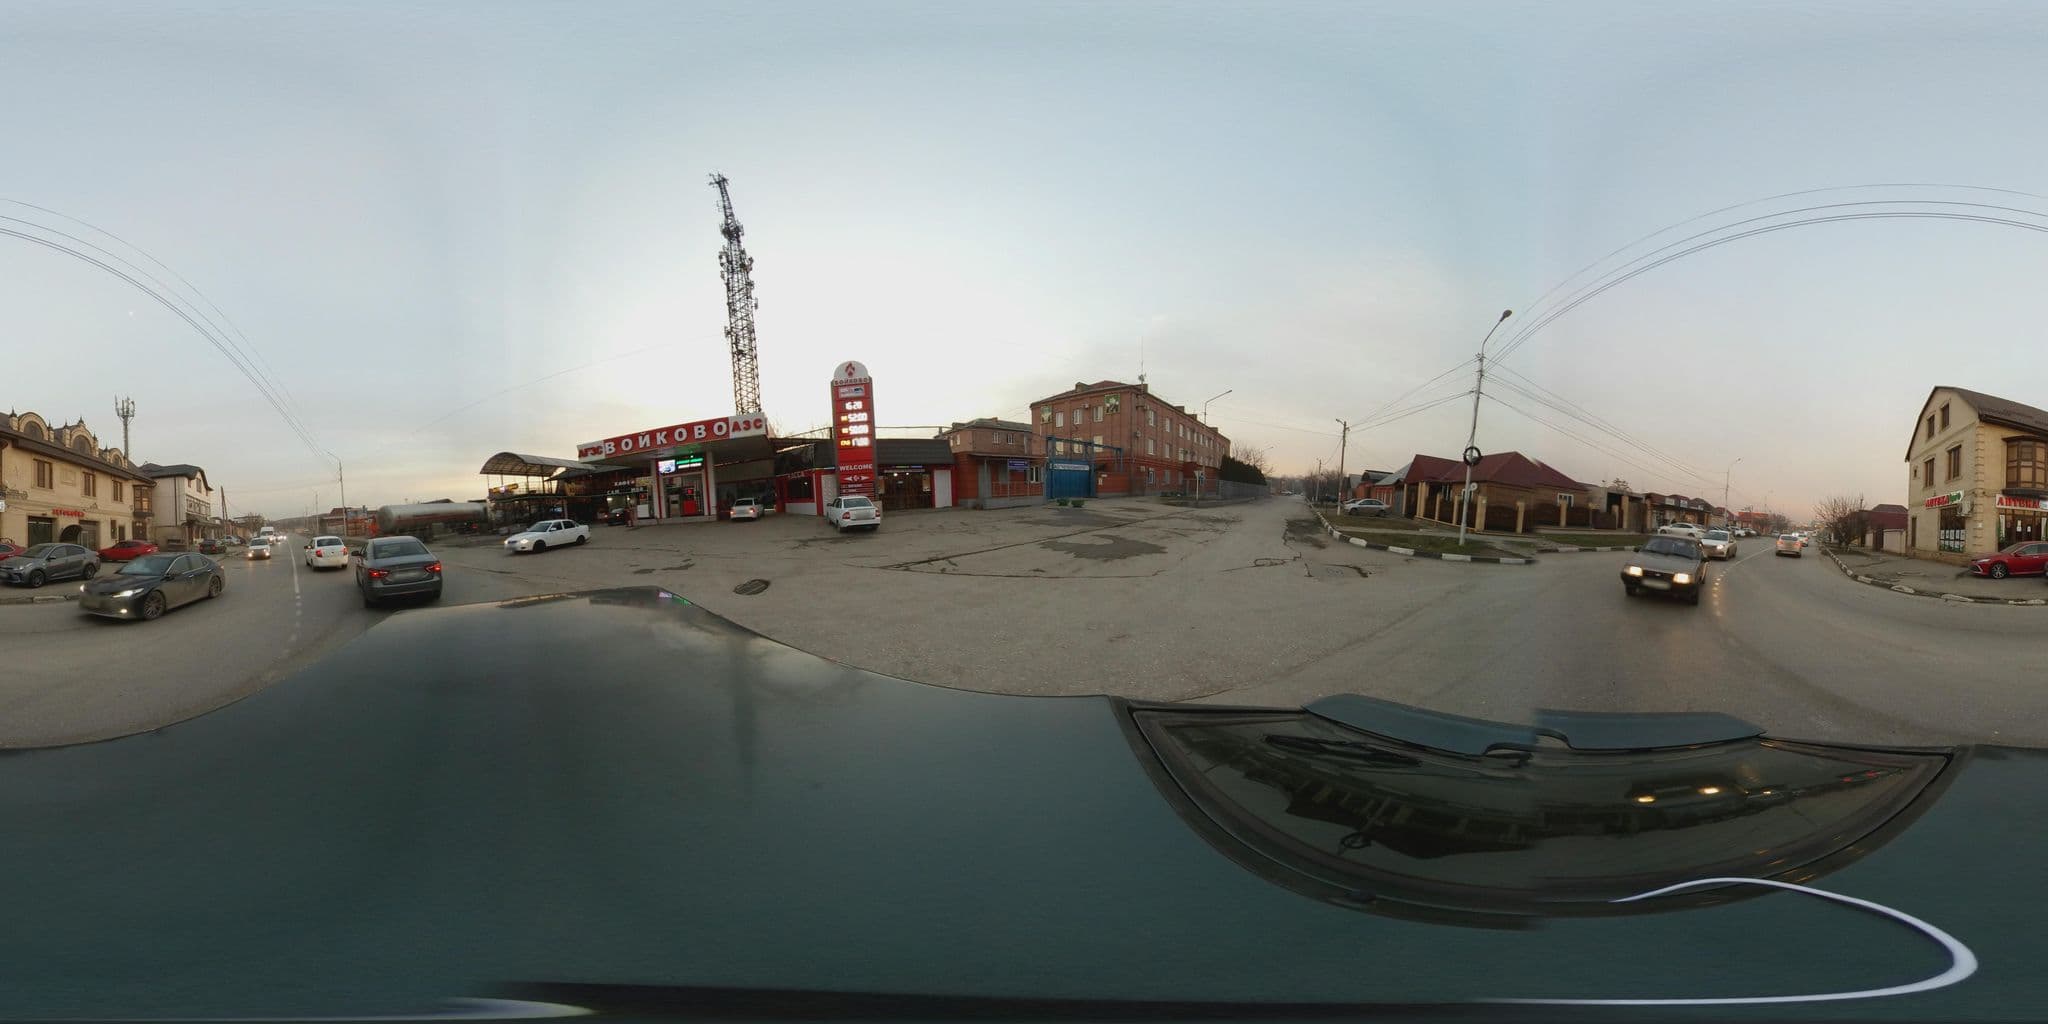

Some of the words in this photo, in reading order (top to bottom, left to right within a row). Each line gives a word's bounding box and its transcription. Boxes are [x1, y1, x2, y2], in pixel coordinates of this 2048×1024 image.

[605, 421, 728, 455] ВОЙКОВО
[732, 418, 764, 433] АЗС
[839, 464, 873, 472] WELCOME
